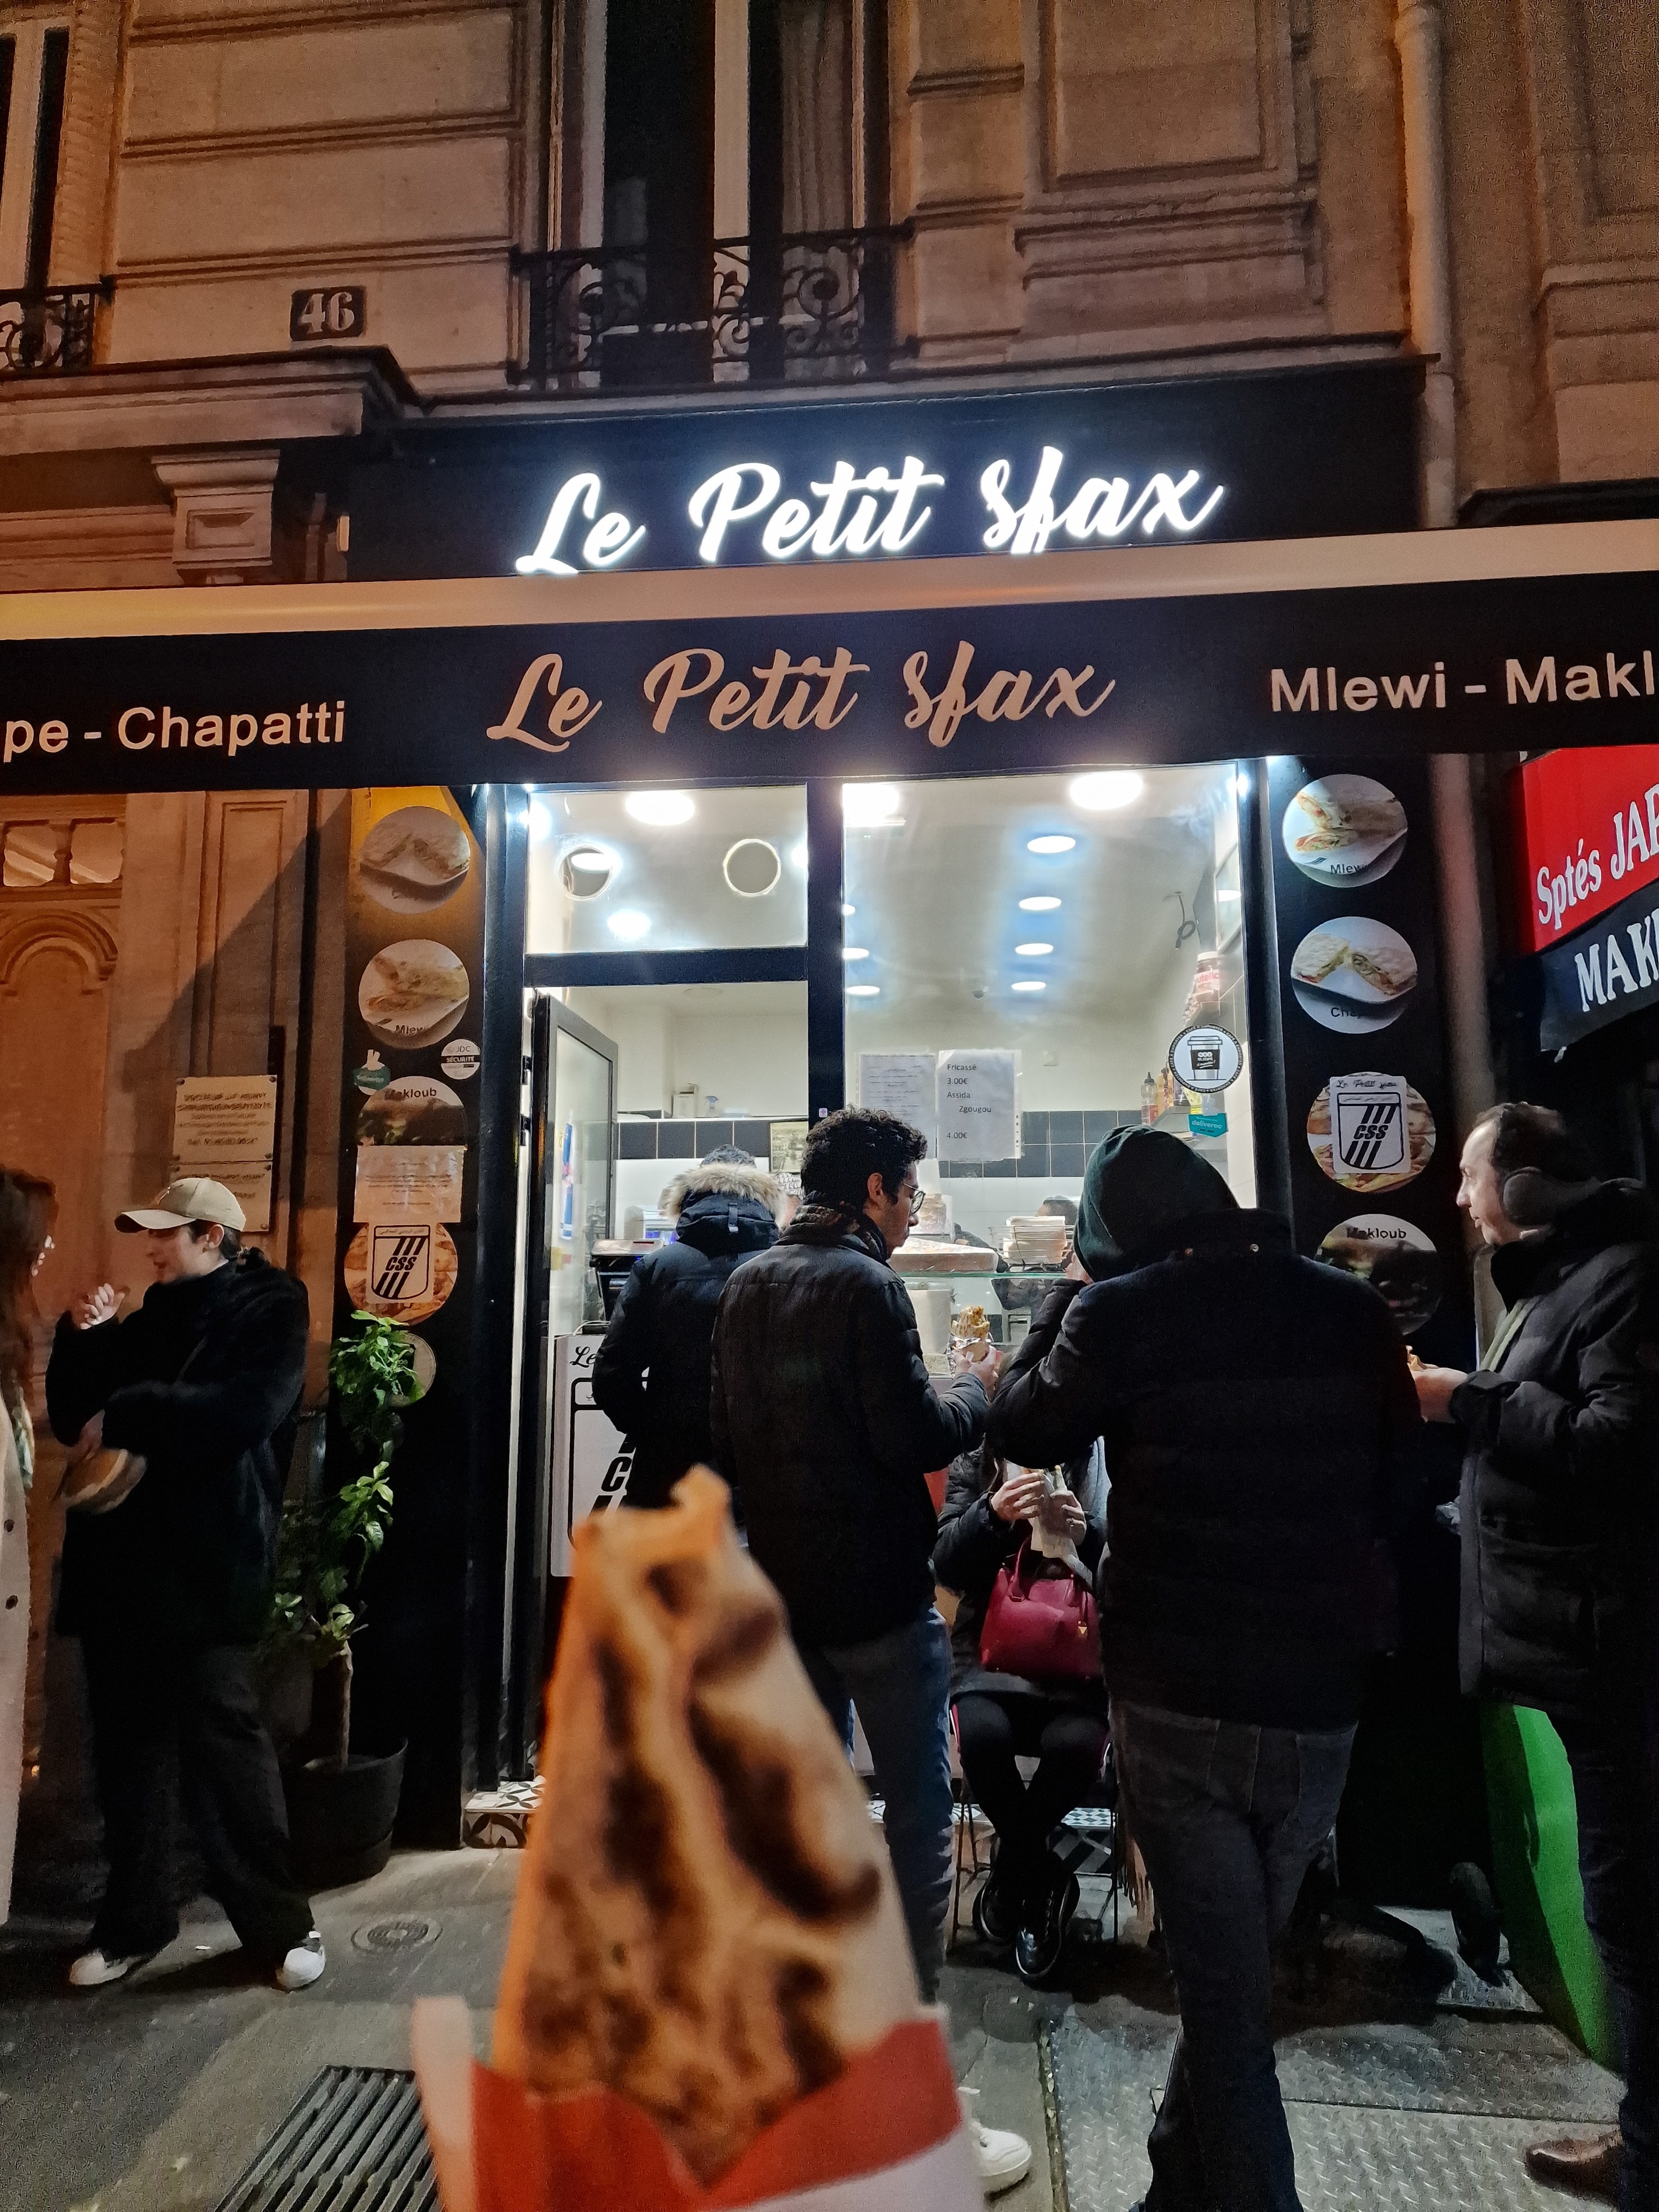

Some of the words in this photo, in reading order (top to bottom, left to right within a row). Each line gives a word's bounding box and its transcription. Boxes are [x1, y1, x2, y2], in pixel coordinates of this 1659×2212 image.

[300, 292, 354, 331] 46
[515, 472, 647, 574] Le
[688, 456, 946, 562] Petit
[979, 445, 1224, 554] Sfax
[486, 654, 603, 753] Le
[643, 646, 870, 734] Petit
[903, 640, 1117, 748] Sfax
[1271, 661, 1446, 712] Mlewi
[1505, 650, 1655, 705] Makl
[3, 720, 69, 763] pe
[118, 700, 345, 757] Chapatti
[1537, 838, 1602, 930] Sptés
[959, 1105, 992, 1114] Zgougou
[1191, 1119, 1222, 1129] deliveroo
[1353, 1124, 1389, 1140] CSS
[385, 1256, 418, 1271] CSS
